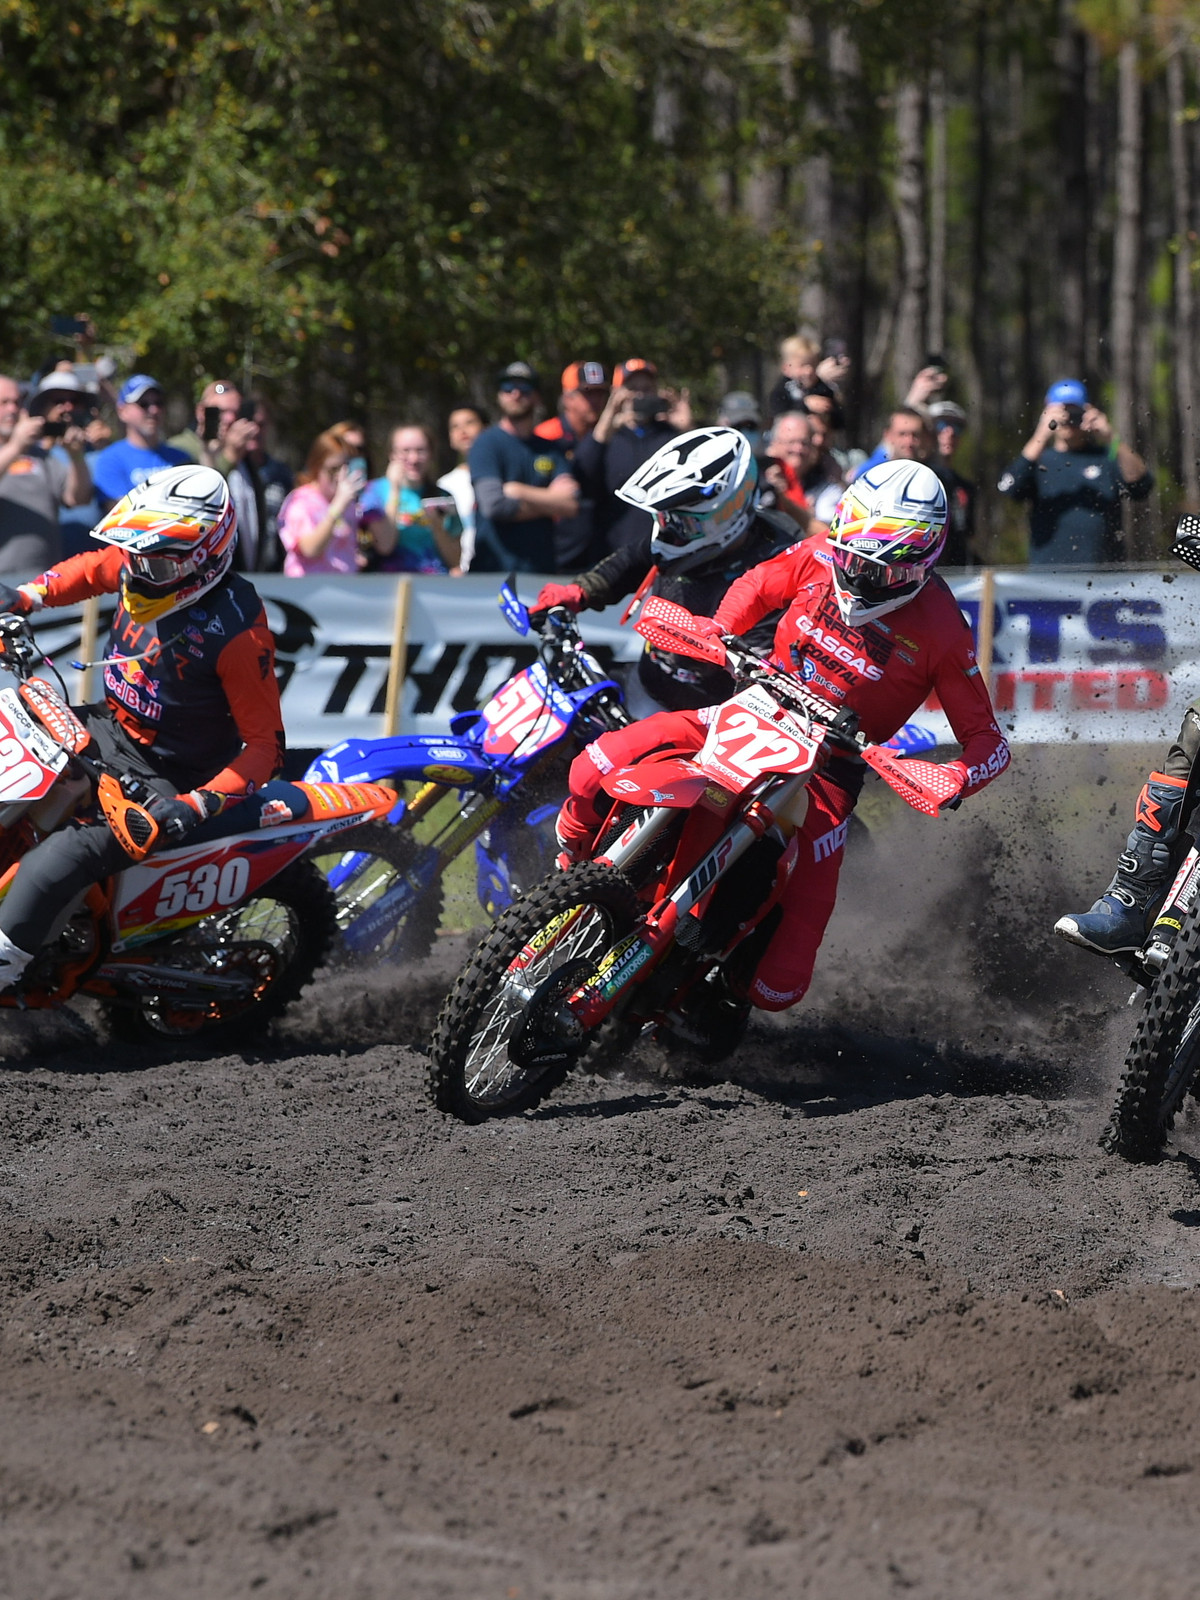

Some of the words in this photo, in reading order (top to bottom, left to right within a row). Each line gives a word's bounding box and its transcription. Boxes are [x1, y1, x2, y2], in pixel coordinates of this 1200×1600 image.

[852, 540, 879, 549] SHOEI
[657, 624, 705, 651] ACERBIS
[795, 615, 885, 682] GASGAS
[712, 711, 801, 778] 212
[882, 764, 924, 794] ACERBIS
[154, 856, 250, 918] 530
[596, 939, 642, 991] DUNLOP
[613, 948, 650, 988] MOTOREX
